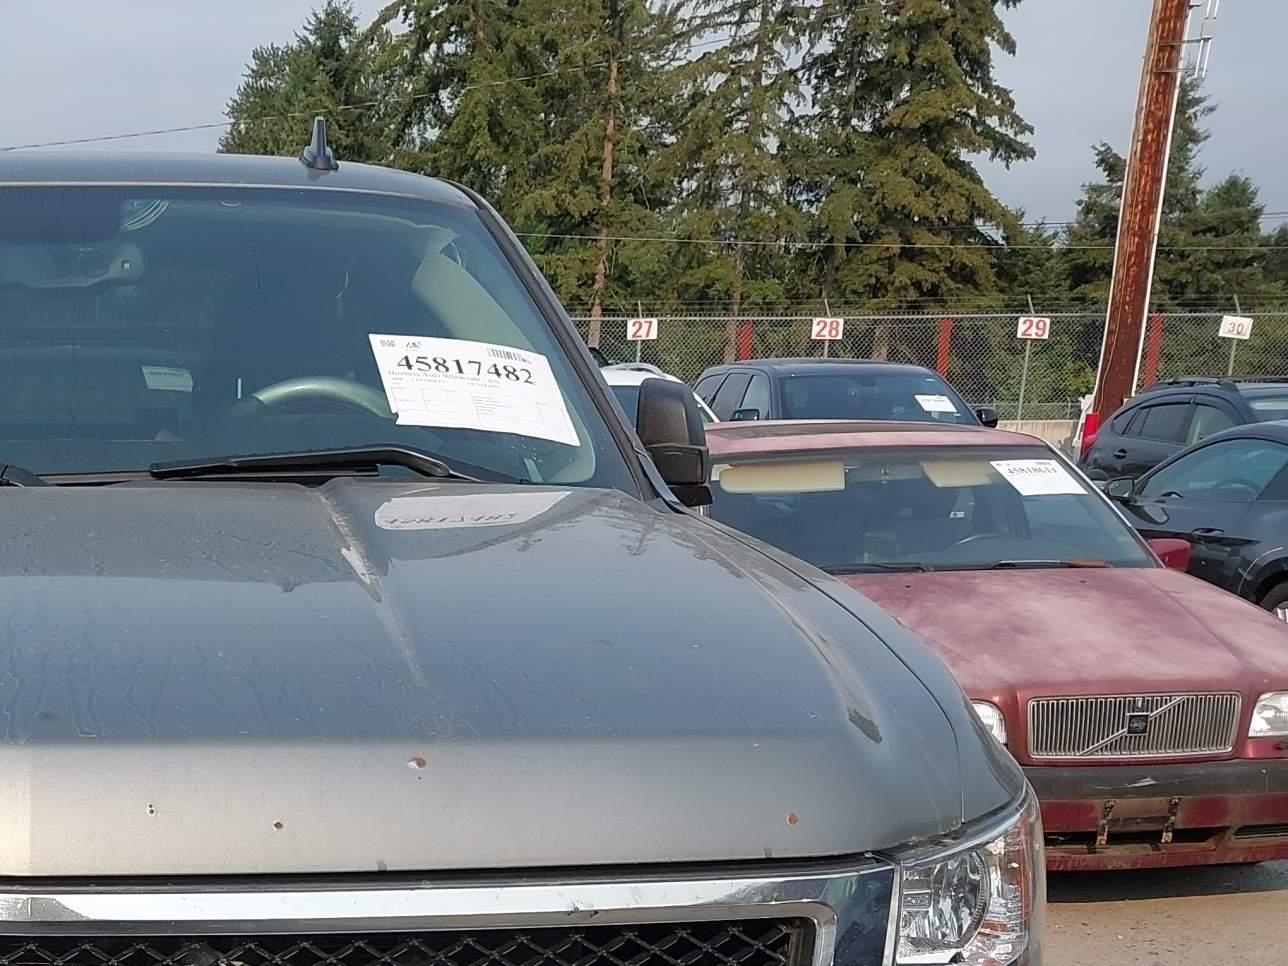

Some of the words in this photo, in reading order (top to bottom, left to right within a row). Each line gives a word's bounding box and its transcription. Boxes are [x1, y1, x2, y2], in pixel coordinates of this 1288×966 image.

[632, 320, 652, 338] 27
[815, 320, 840, 337] 28
[1021, 319, 1047, 337] 29
[1228, 322, 1244, 334] 30
[397, 355, 537, 385] 45817482
